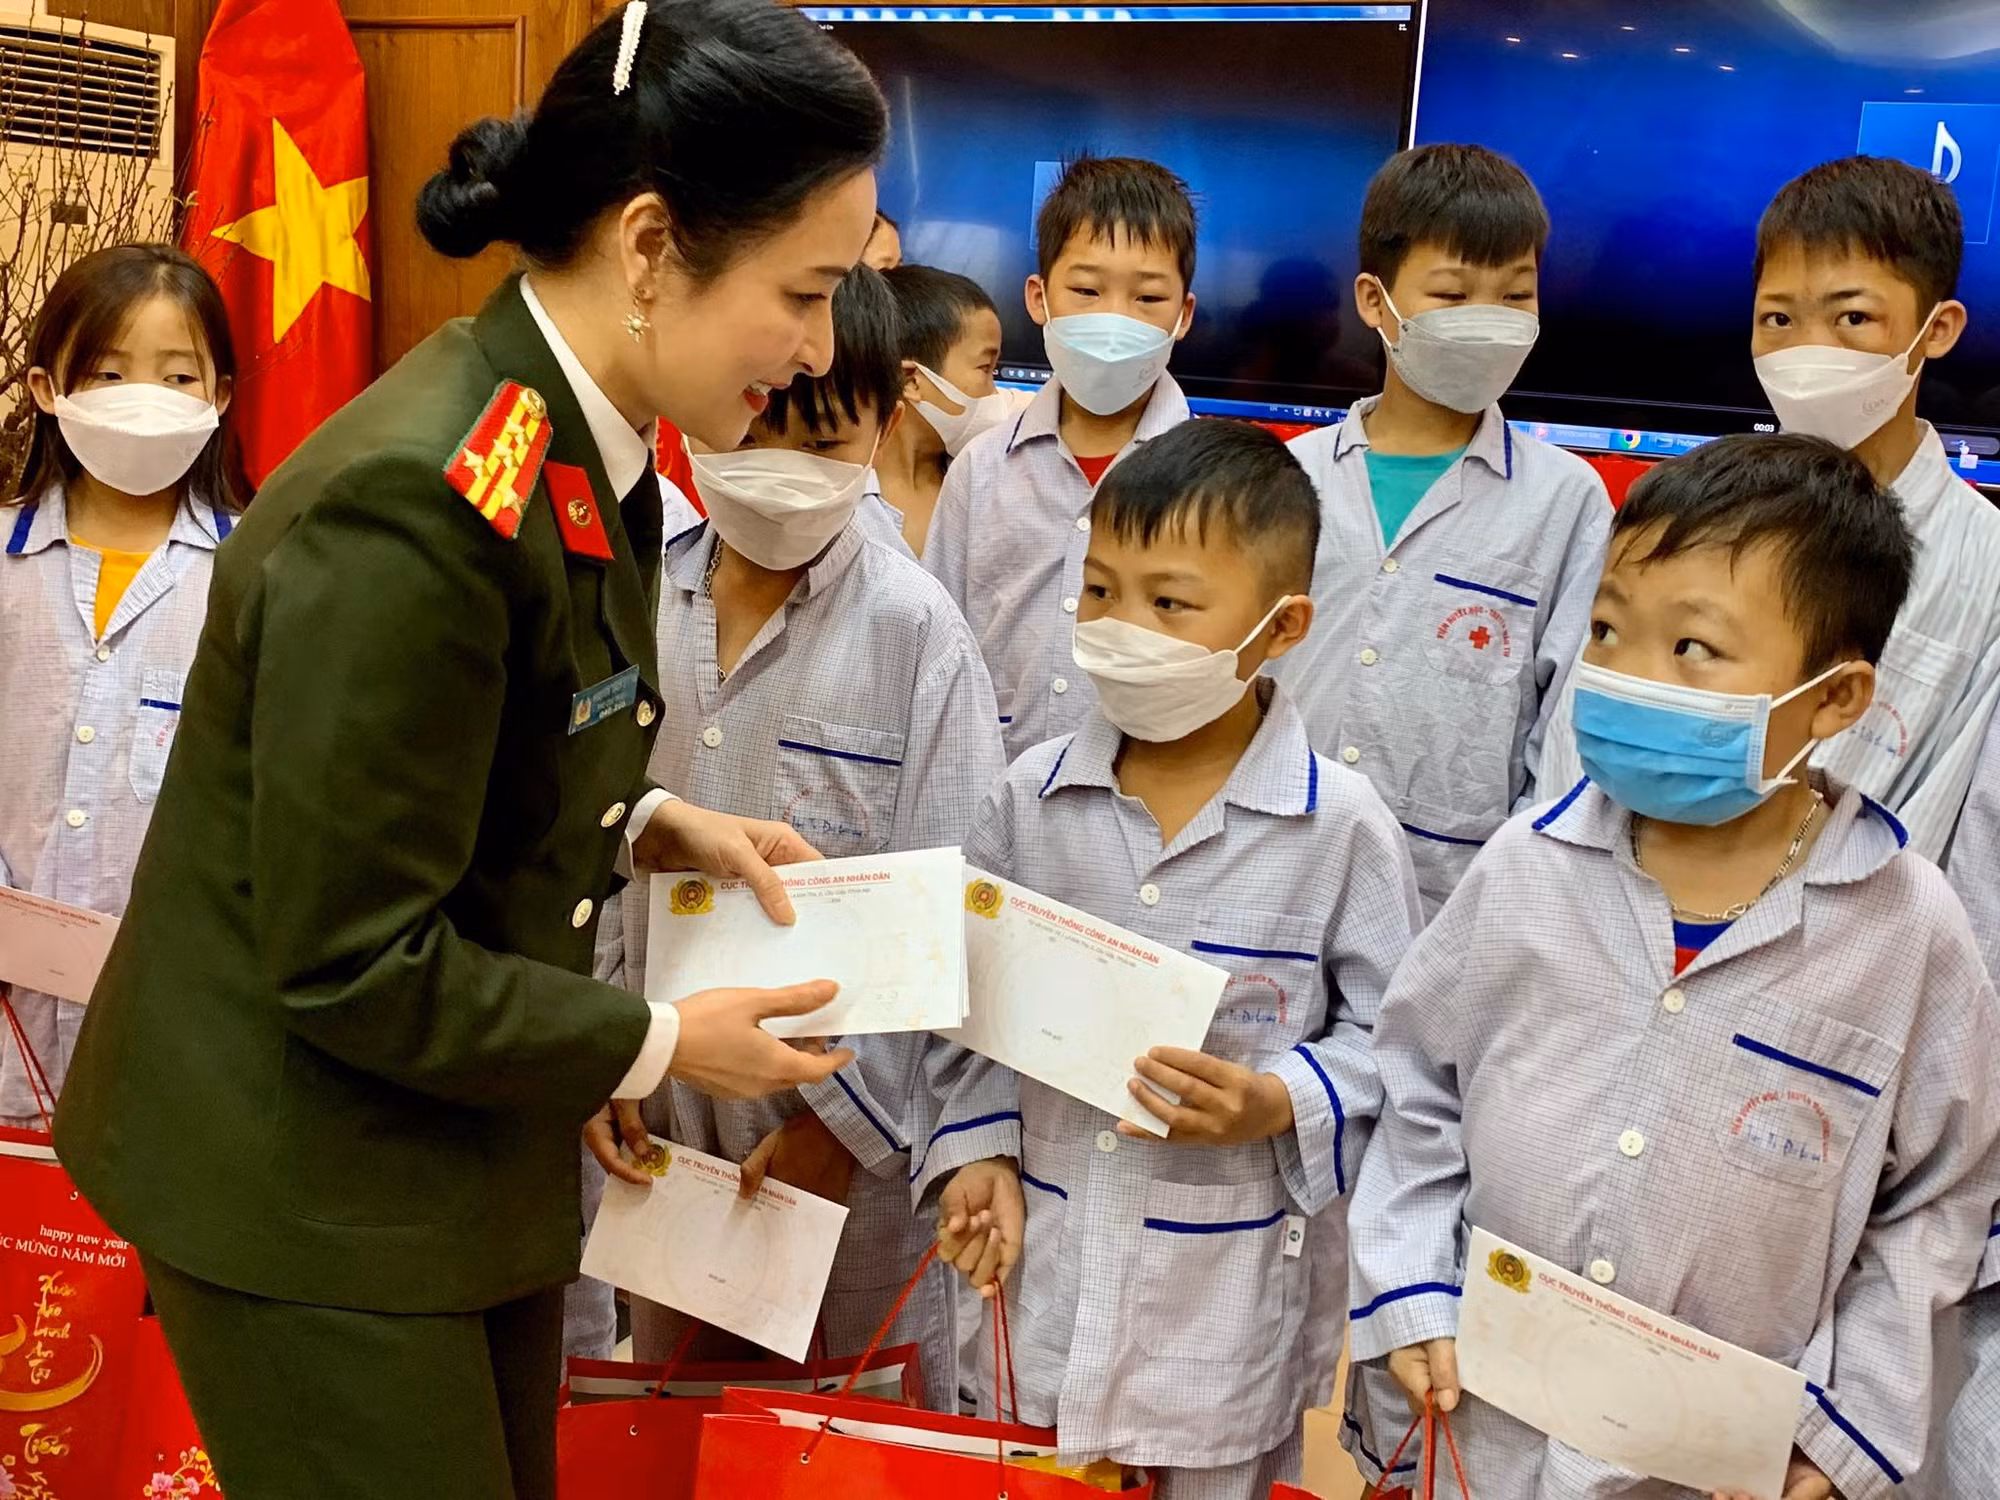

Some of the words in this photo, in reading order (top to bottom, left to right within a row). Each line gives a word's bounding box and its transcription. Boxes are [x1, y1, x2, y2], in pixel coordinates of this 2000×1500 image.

[1753, 423, 1775, 432] 00:03
[720, 881, 740, 890] CỤC
[781, 878, 806, 888] HÔNG
[807, 875, 831, 887] CÔNG
[833, 876, 845, 884] AN
[846, 873, 872, 883] NHÂN
[873, 871, 891, 881] DÂN
[1009, 896, 1027, 909] CỤC
[1027, 903, 1057, 921] TRUYỀN
[1058, 915, 1084, 933] THÔNG
[1085, 927, 1107, 942] CÔNG
[1107, 937, 1119, 946] AN
[1120, 942, 1143, 957] NHÂN
[1142, 951, 1160, 964] DÂN
[721, 1170, 740, 1182] THÔN
[39, 1224, 74, 1244] happy
[76, 1233, 101, 1245] new
[103, 1238, 130, 1250] year
[15, 1238, 59, 1258] MỪNG
[61, 1247, 95, 1264] NĂM
[97, 1252, 127, 1268] MỚI
[1626, 1313, 1654, 1331] CÔNG
[1654, 1327, 1669, 1338] AN
[1699, 1346, 1720, 1361] DÂN
